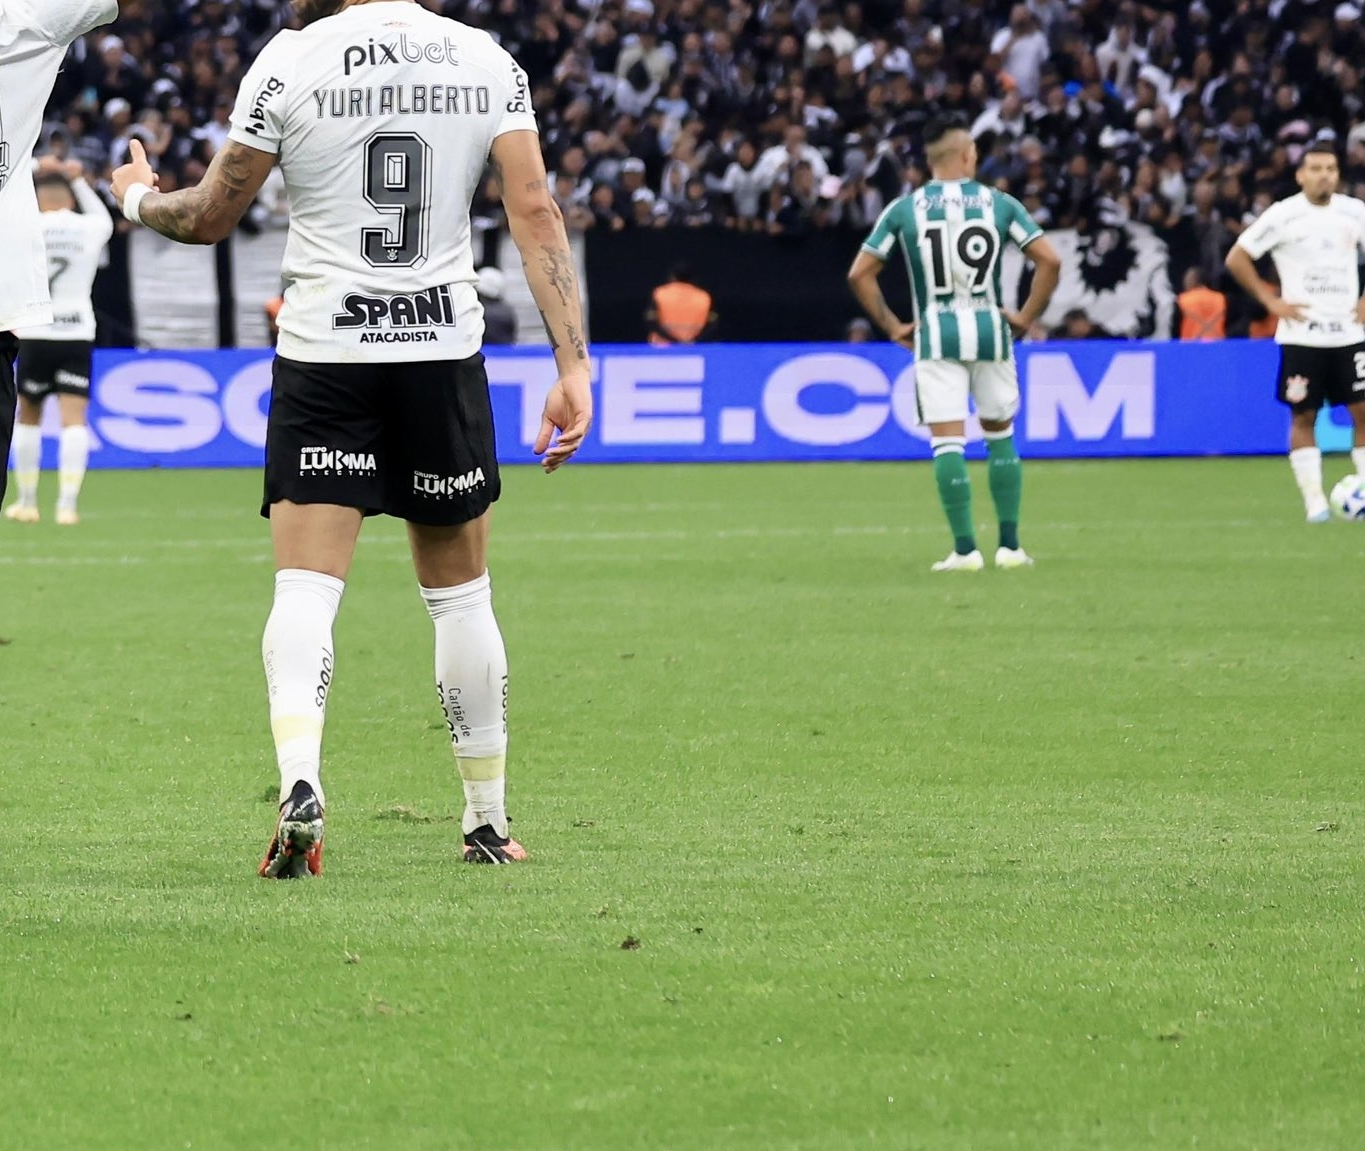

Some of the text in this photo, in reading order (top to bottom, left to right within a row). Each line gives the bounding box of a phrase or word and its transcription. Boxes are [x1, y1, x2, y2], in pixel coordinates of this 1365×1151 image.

[344, 33, 459, 76] pixbet
[249, 76, 285, 122] bmg
[313, 84, 489, 119] YURI ALBERTO
[360, 131, 432, 270] 9
[921, 222, 998, 291] 19
[360, 330, 438, 344] ATACADISTA
[301, 446, 327, 454] GRUPO
[414, 469, 439, 480] GRUPO
[449, 687, 471, 737] Cartão de
